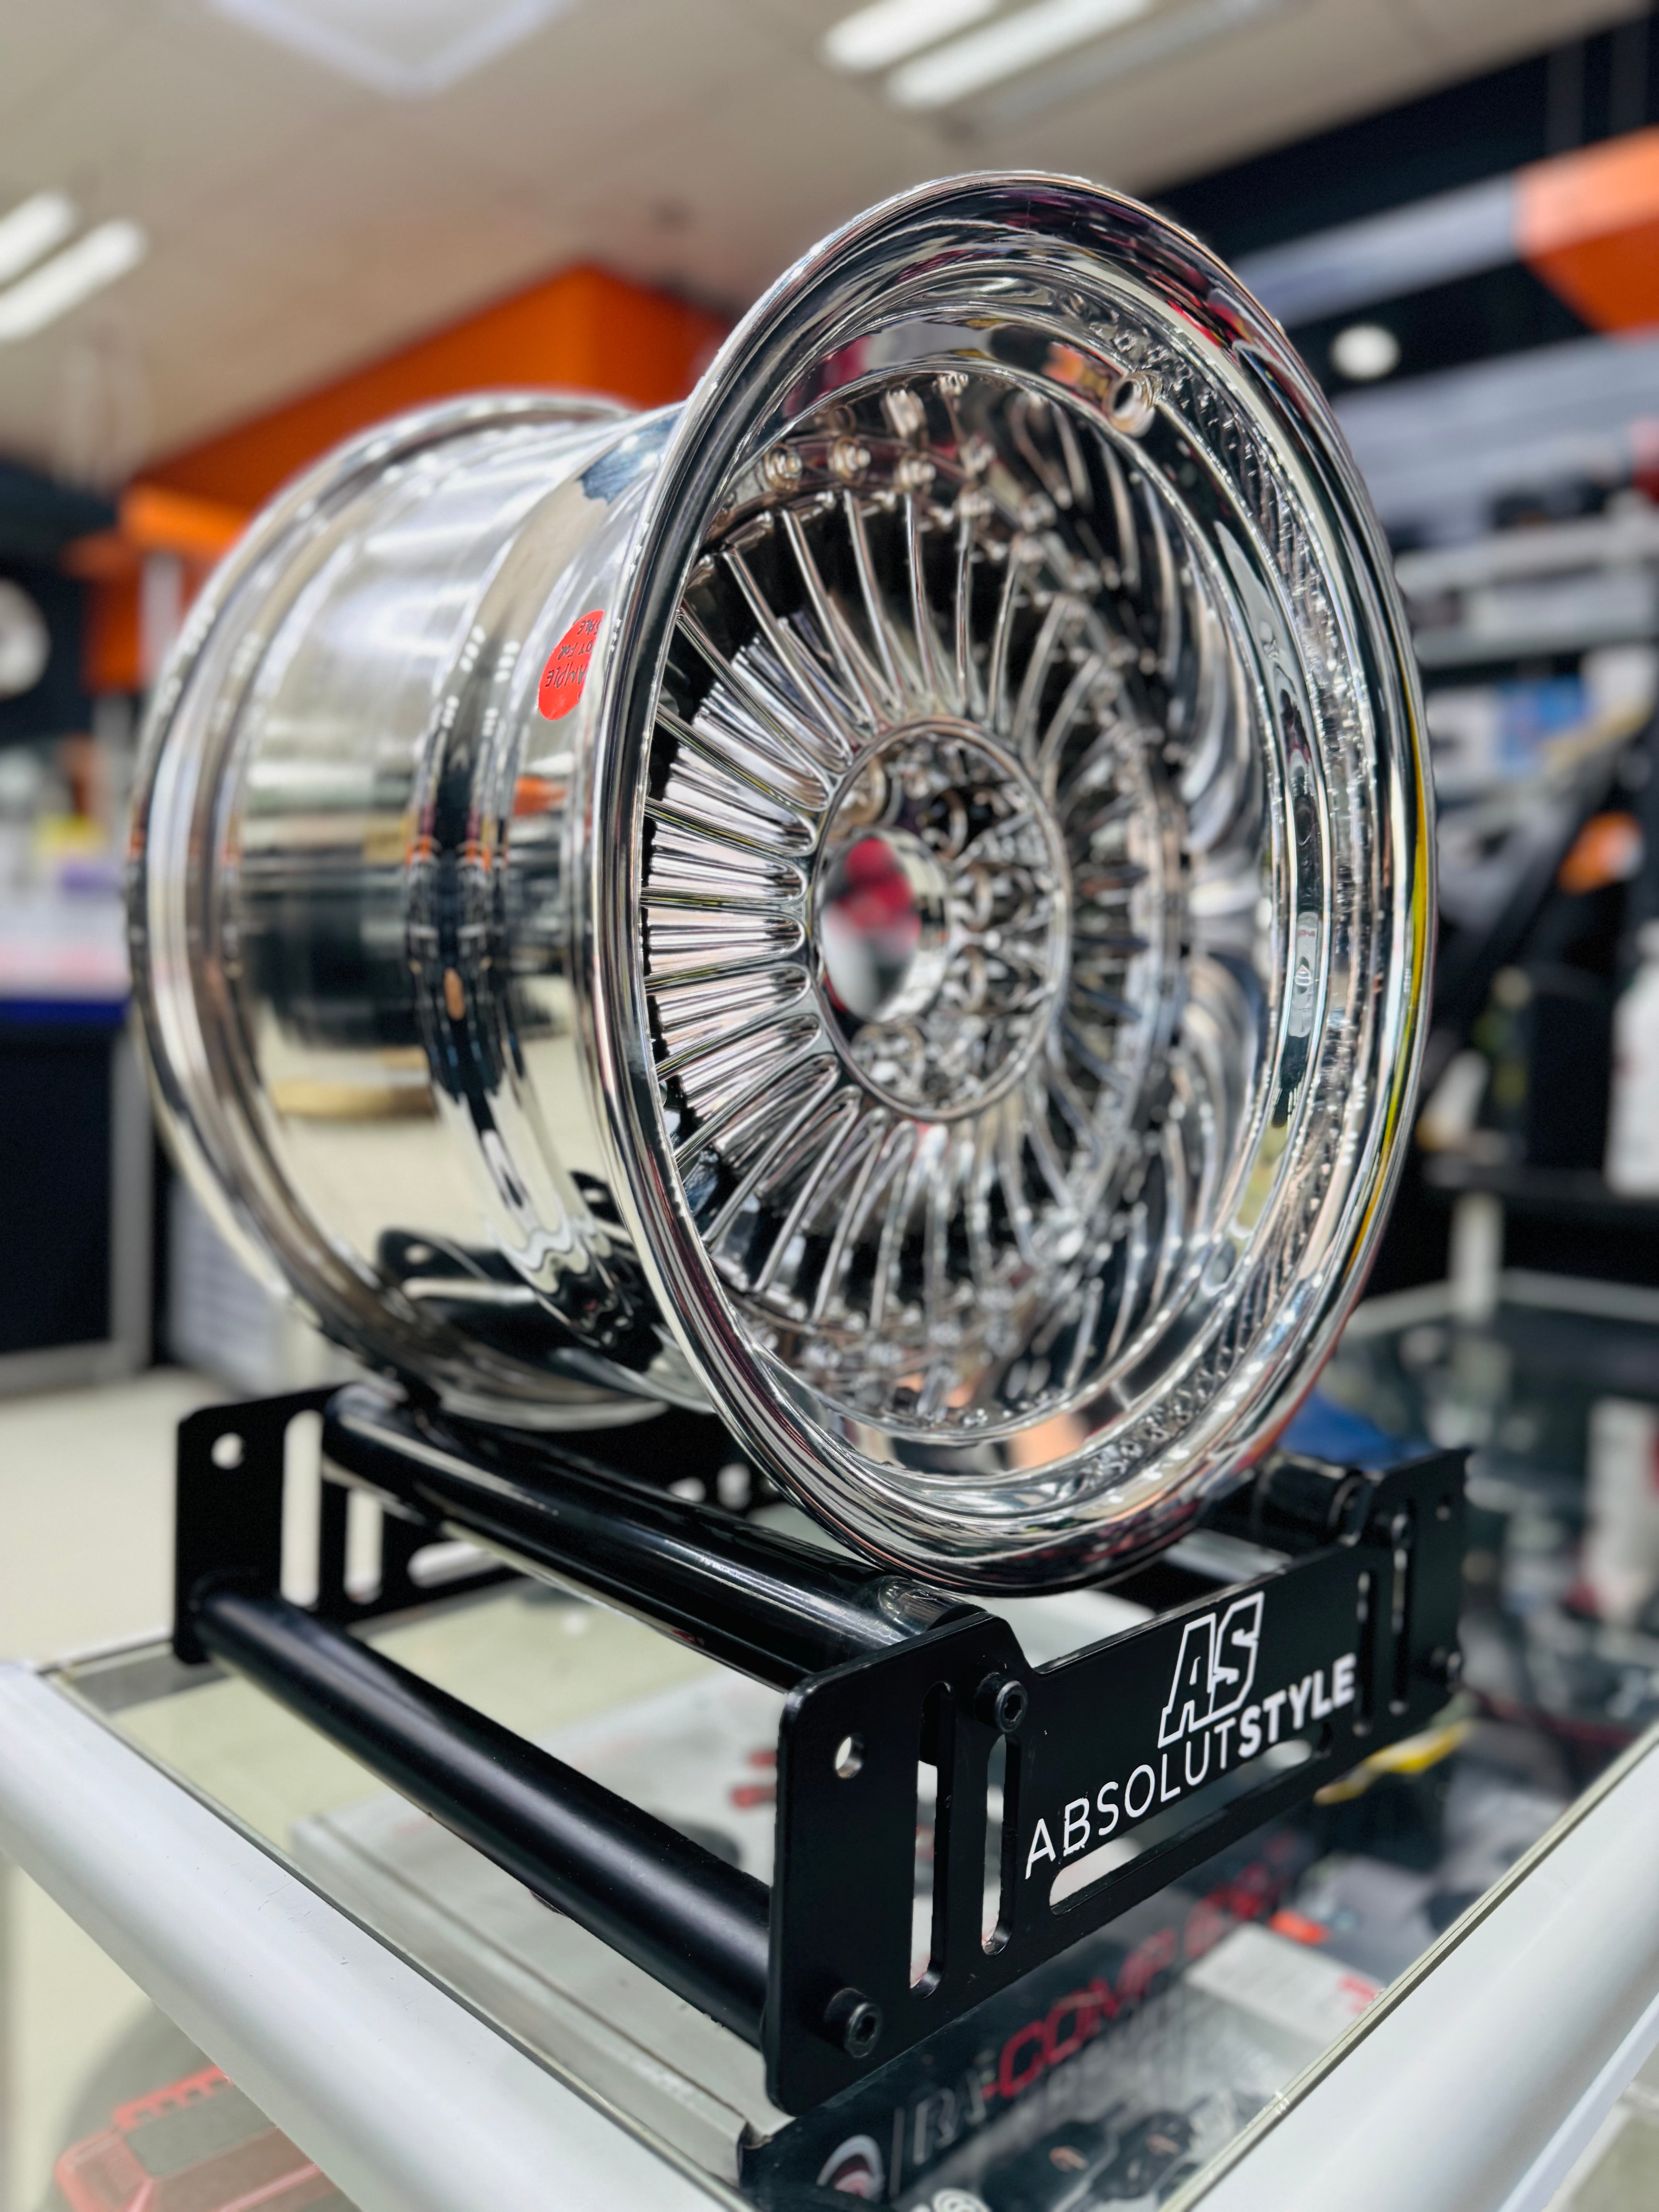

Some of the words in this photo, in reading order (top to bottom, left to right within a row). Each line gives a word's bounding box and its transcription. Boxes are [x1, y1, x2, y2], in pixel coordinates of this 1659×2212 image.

[578, 640, 593, 655] OT
[545, 661, 588, 688] AMPLE
[1157, 1591, 1264, 1749] AS
